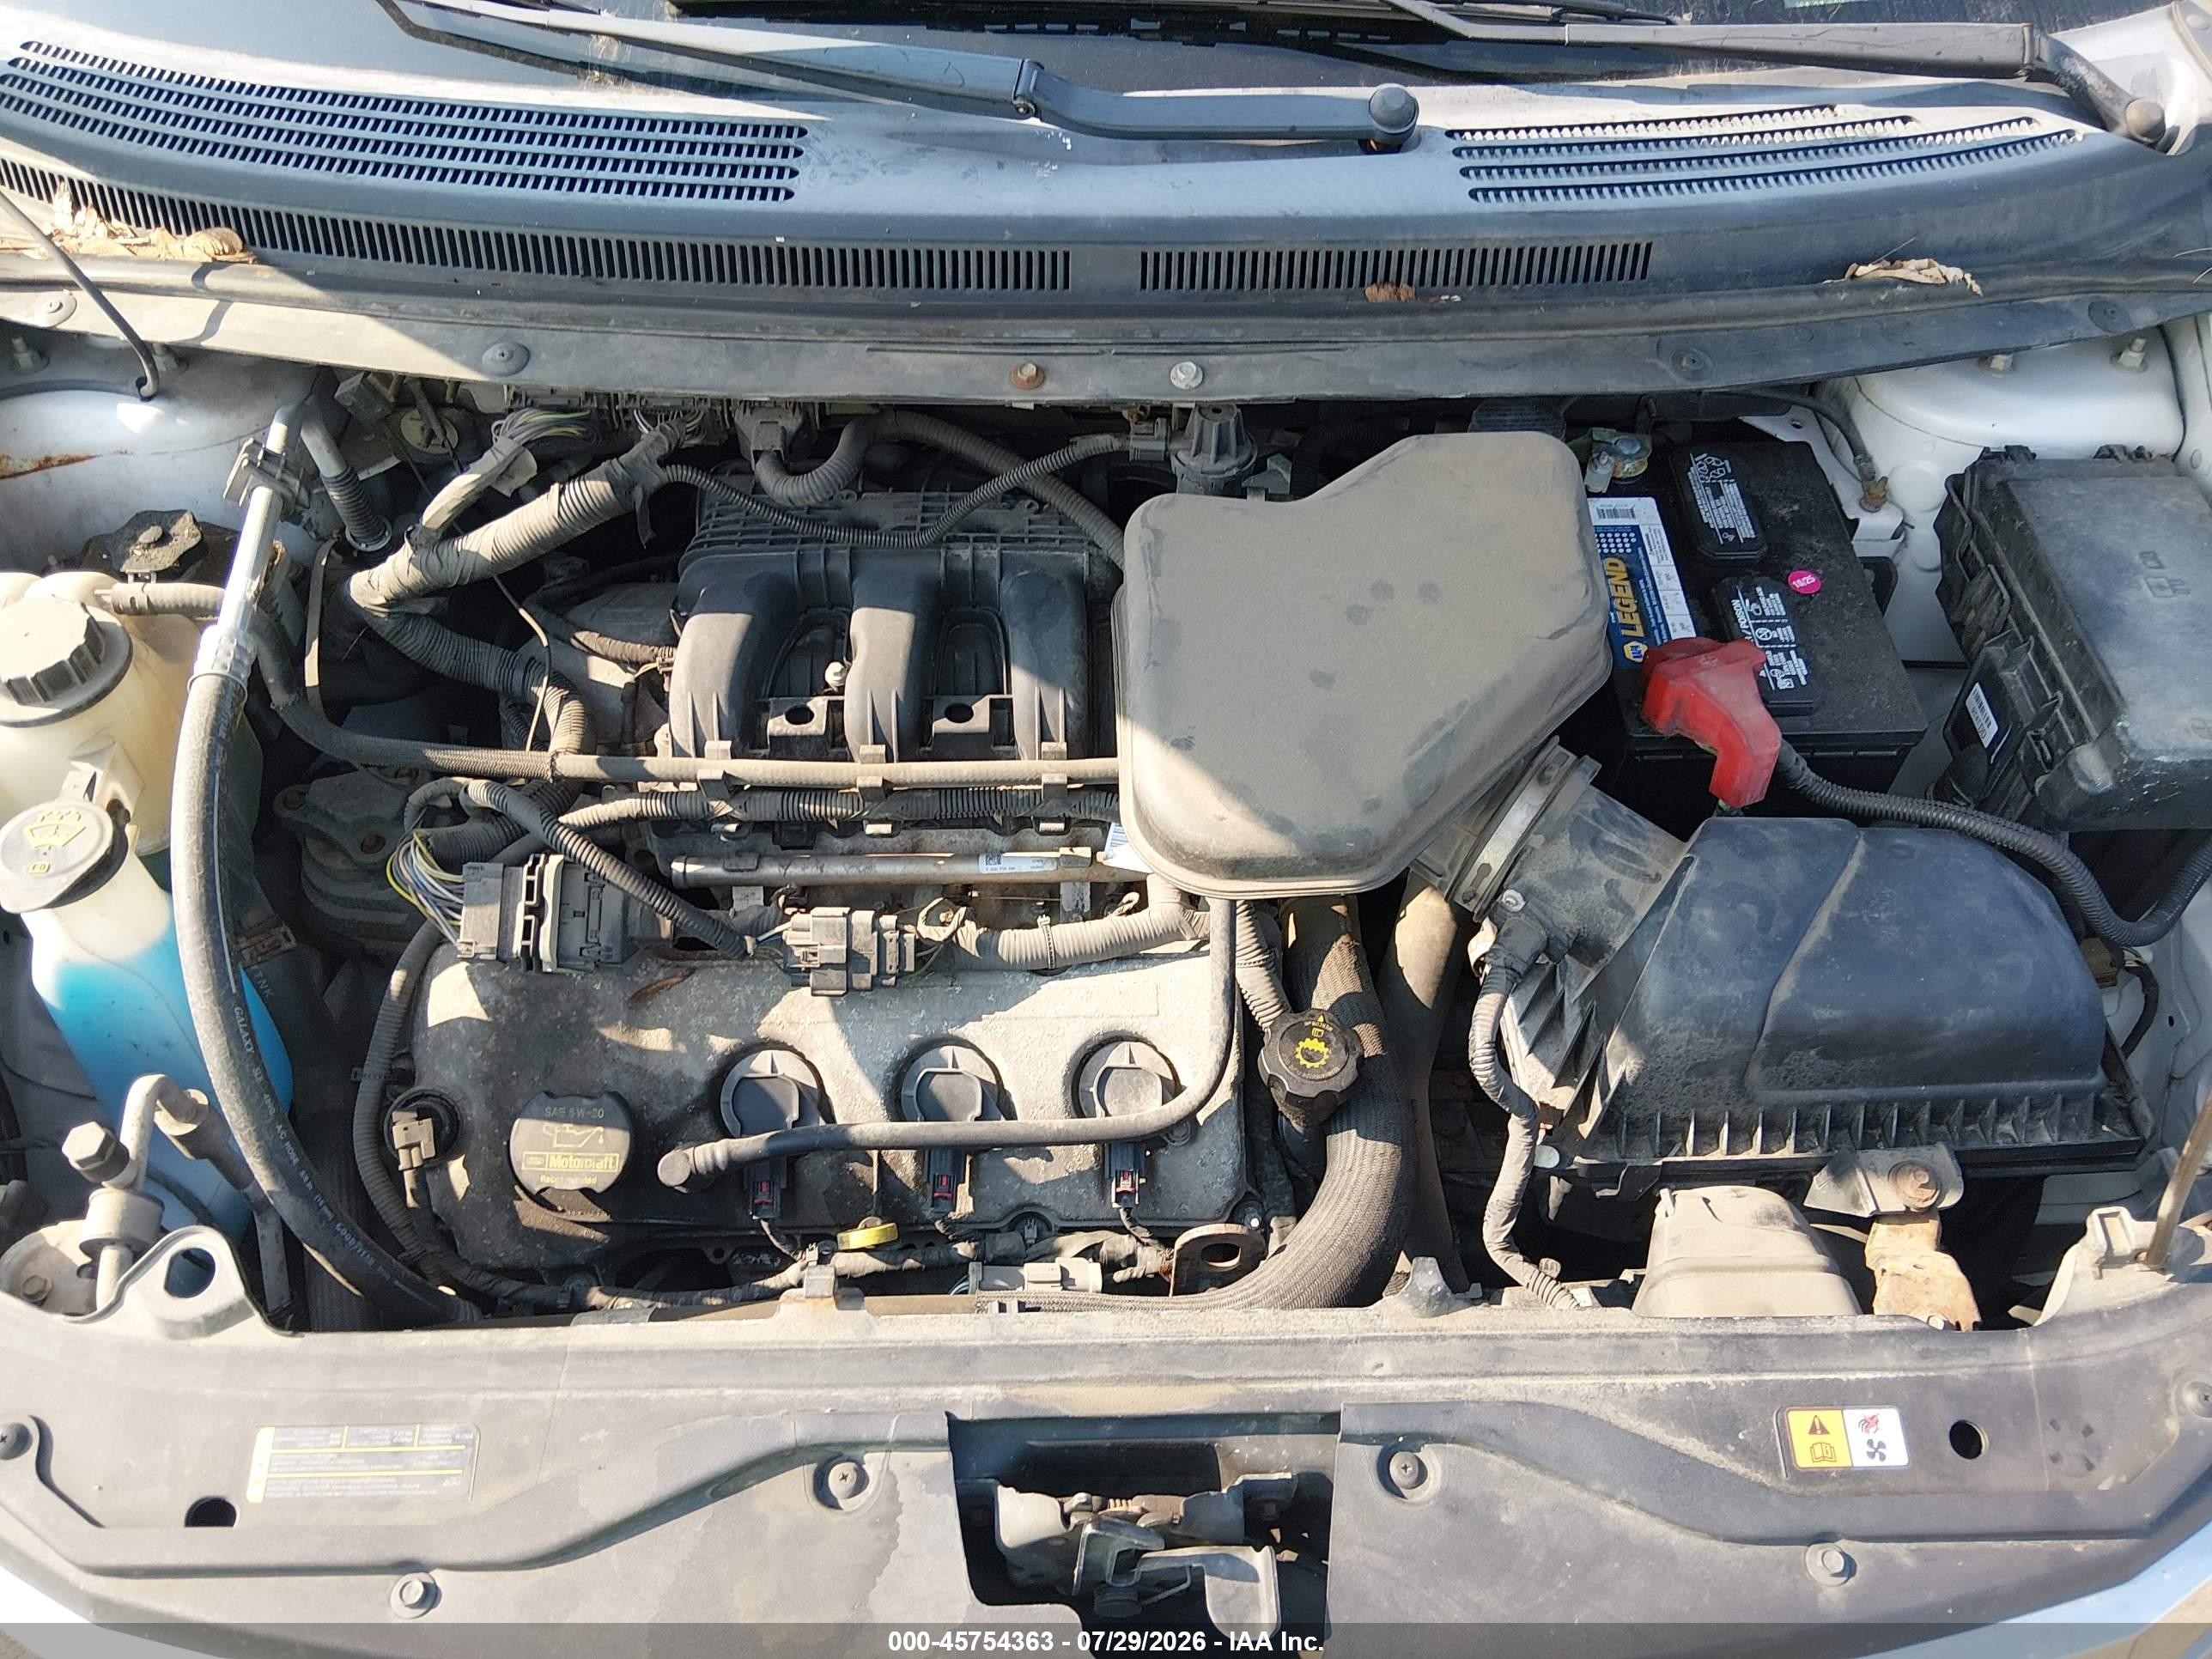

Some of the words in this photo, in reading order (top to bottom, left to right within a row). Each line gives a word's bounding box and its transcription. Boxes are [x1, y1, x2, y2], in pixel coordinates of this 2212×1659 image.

[1603, 557, 1644, 637] LEGEND
[1731, 599, 1749, 629] POISON
[234, 1006, 255, 1054] GALAXY
[544, 1106, 566, 1118] SAE
[568, 1108, 605, 1118] 5W-20
[548, 1154, 615, 1170] Motorcraft
